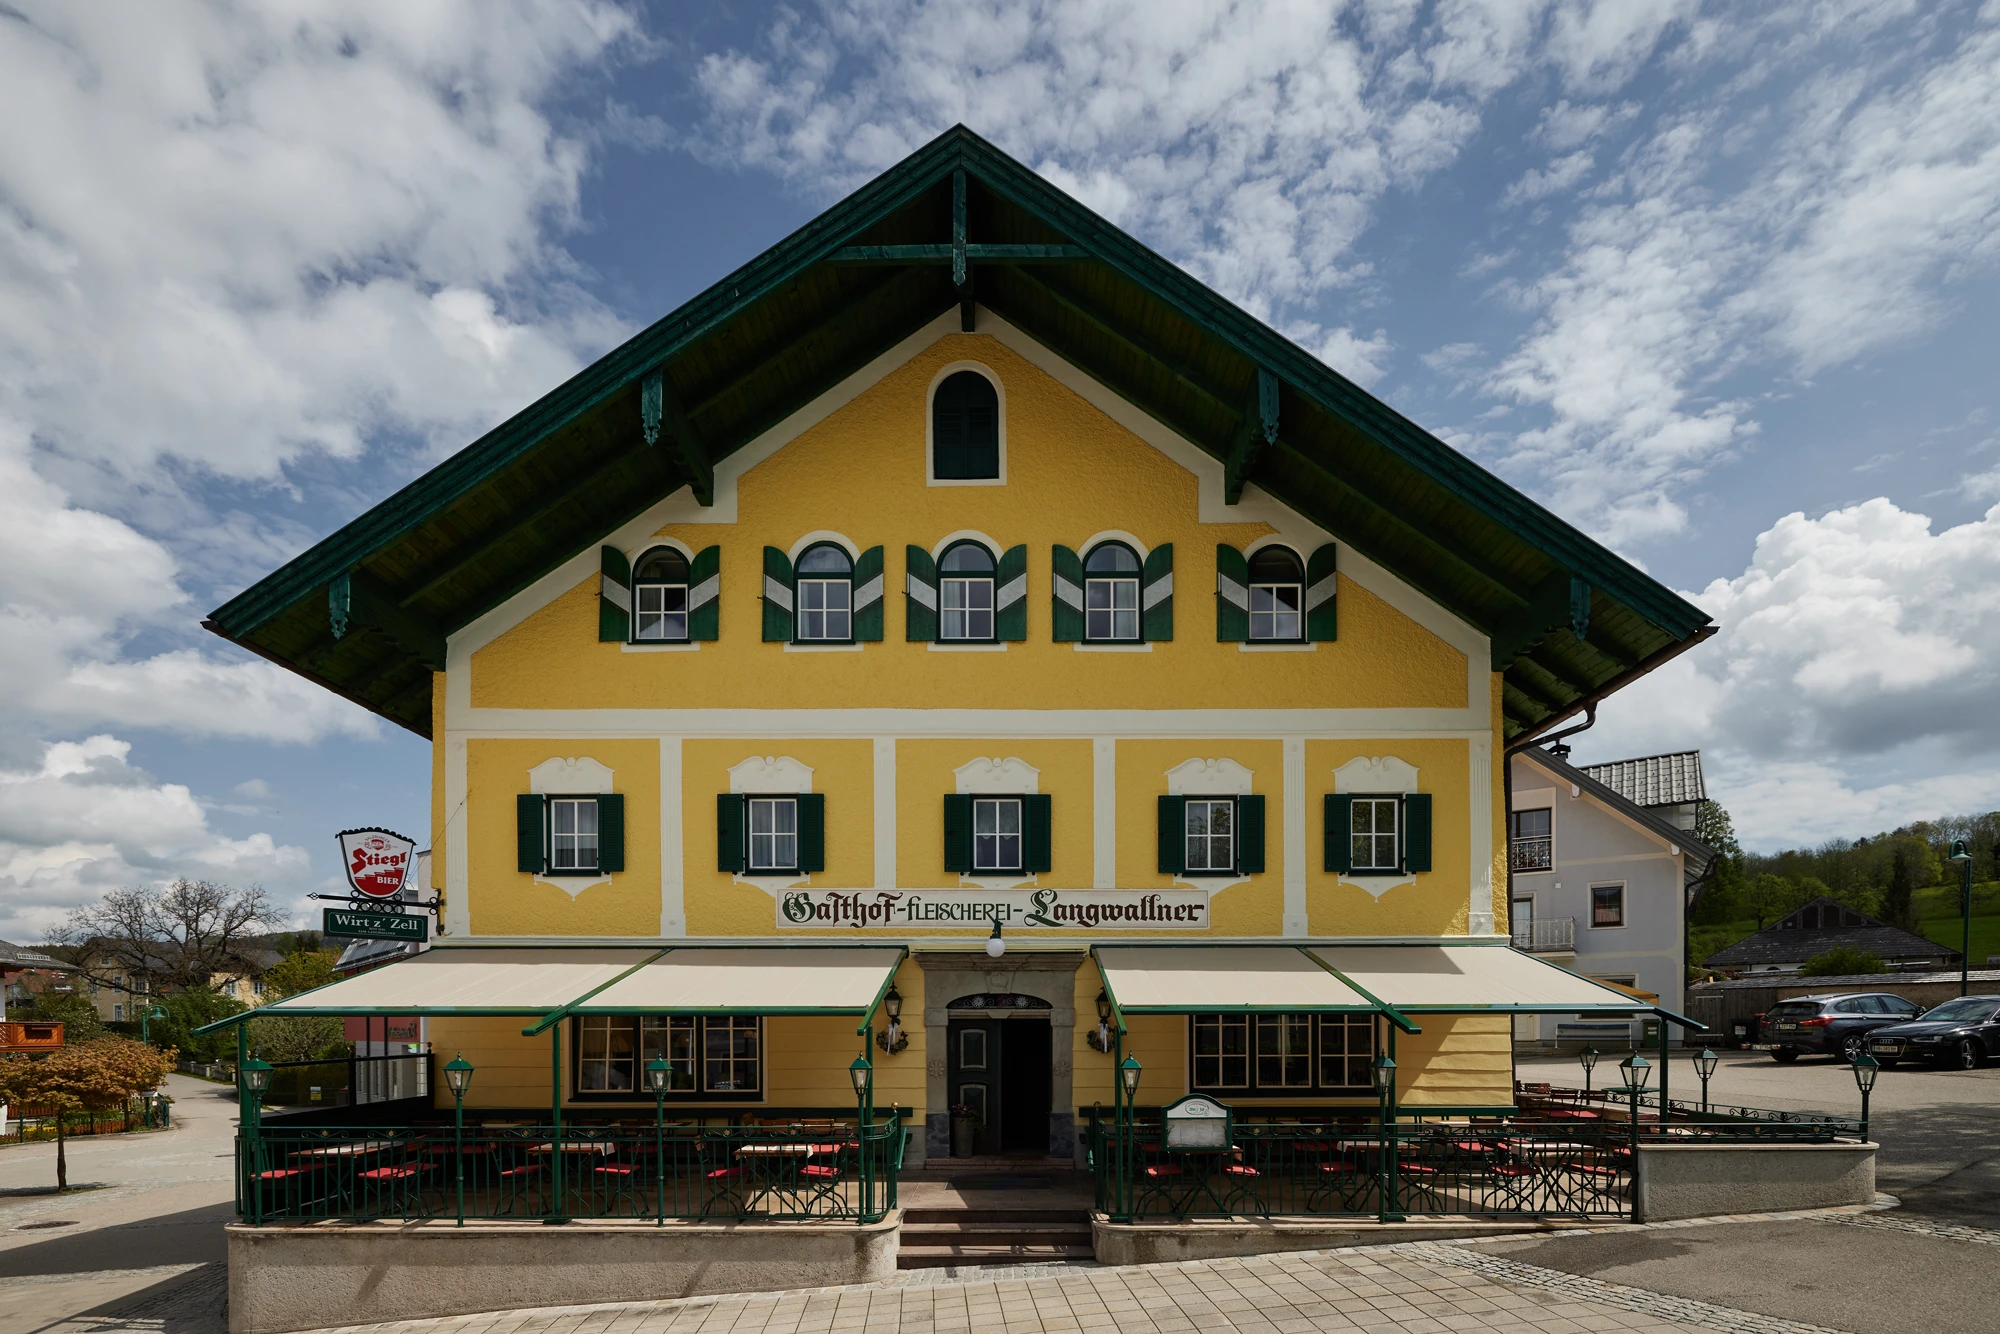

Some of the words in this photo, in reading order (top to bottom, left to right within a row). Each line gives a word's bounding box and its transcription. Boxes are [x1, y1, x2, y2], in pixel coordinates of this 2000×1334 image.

[350, 847, 407, 875] Stiegl
[377, 876, 399, 885] BIER
[335, 914, 370, 927] Wirt
[390, 918, 418, 930] Zell
